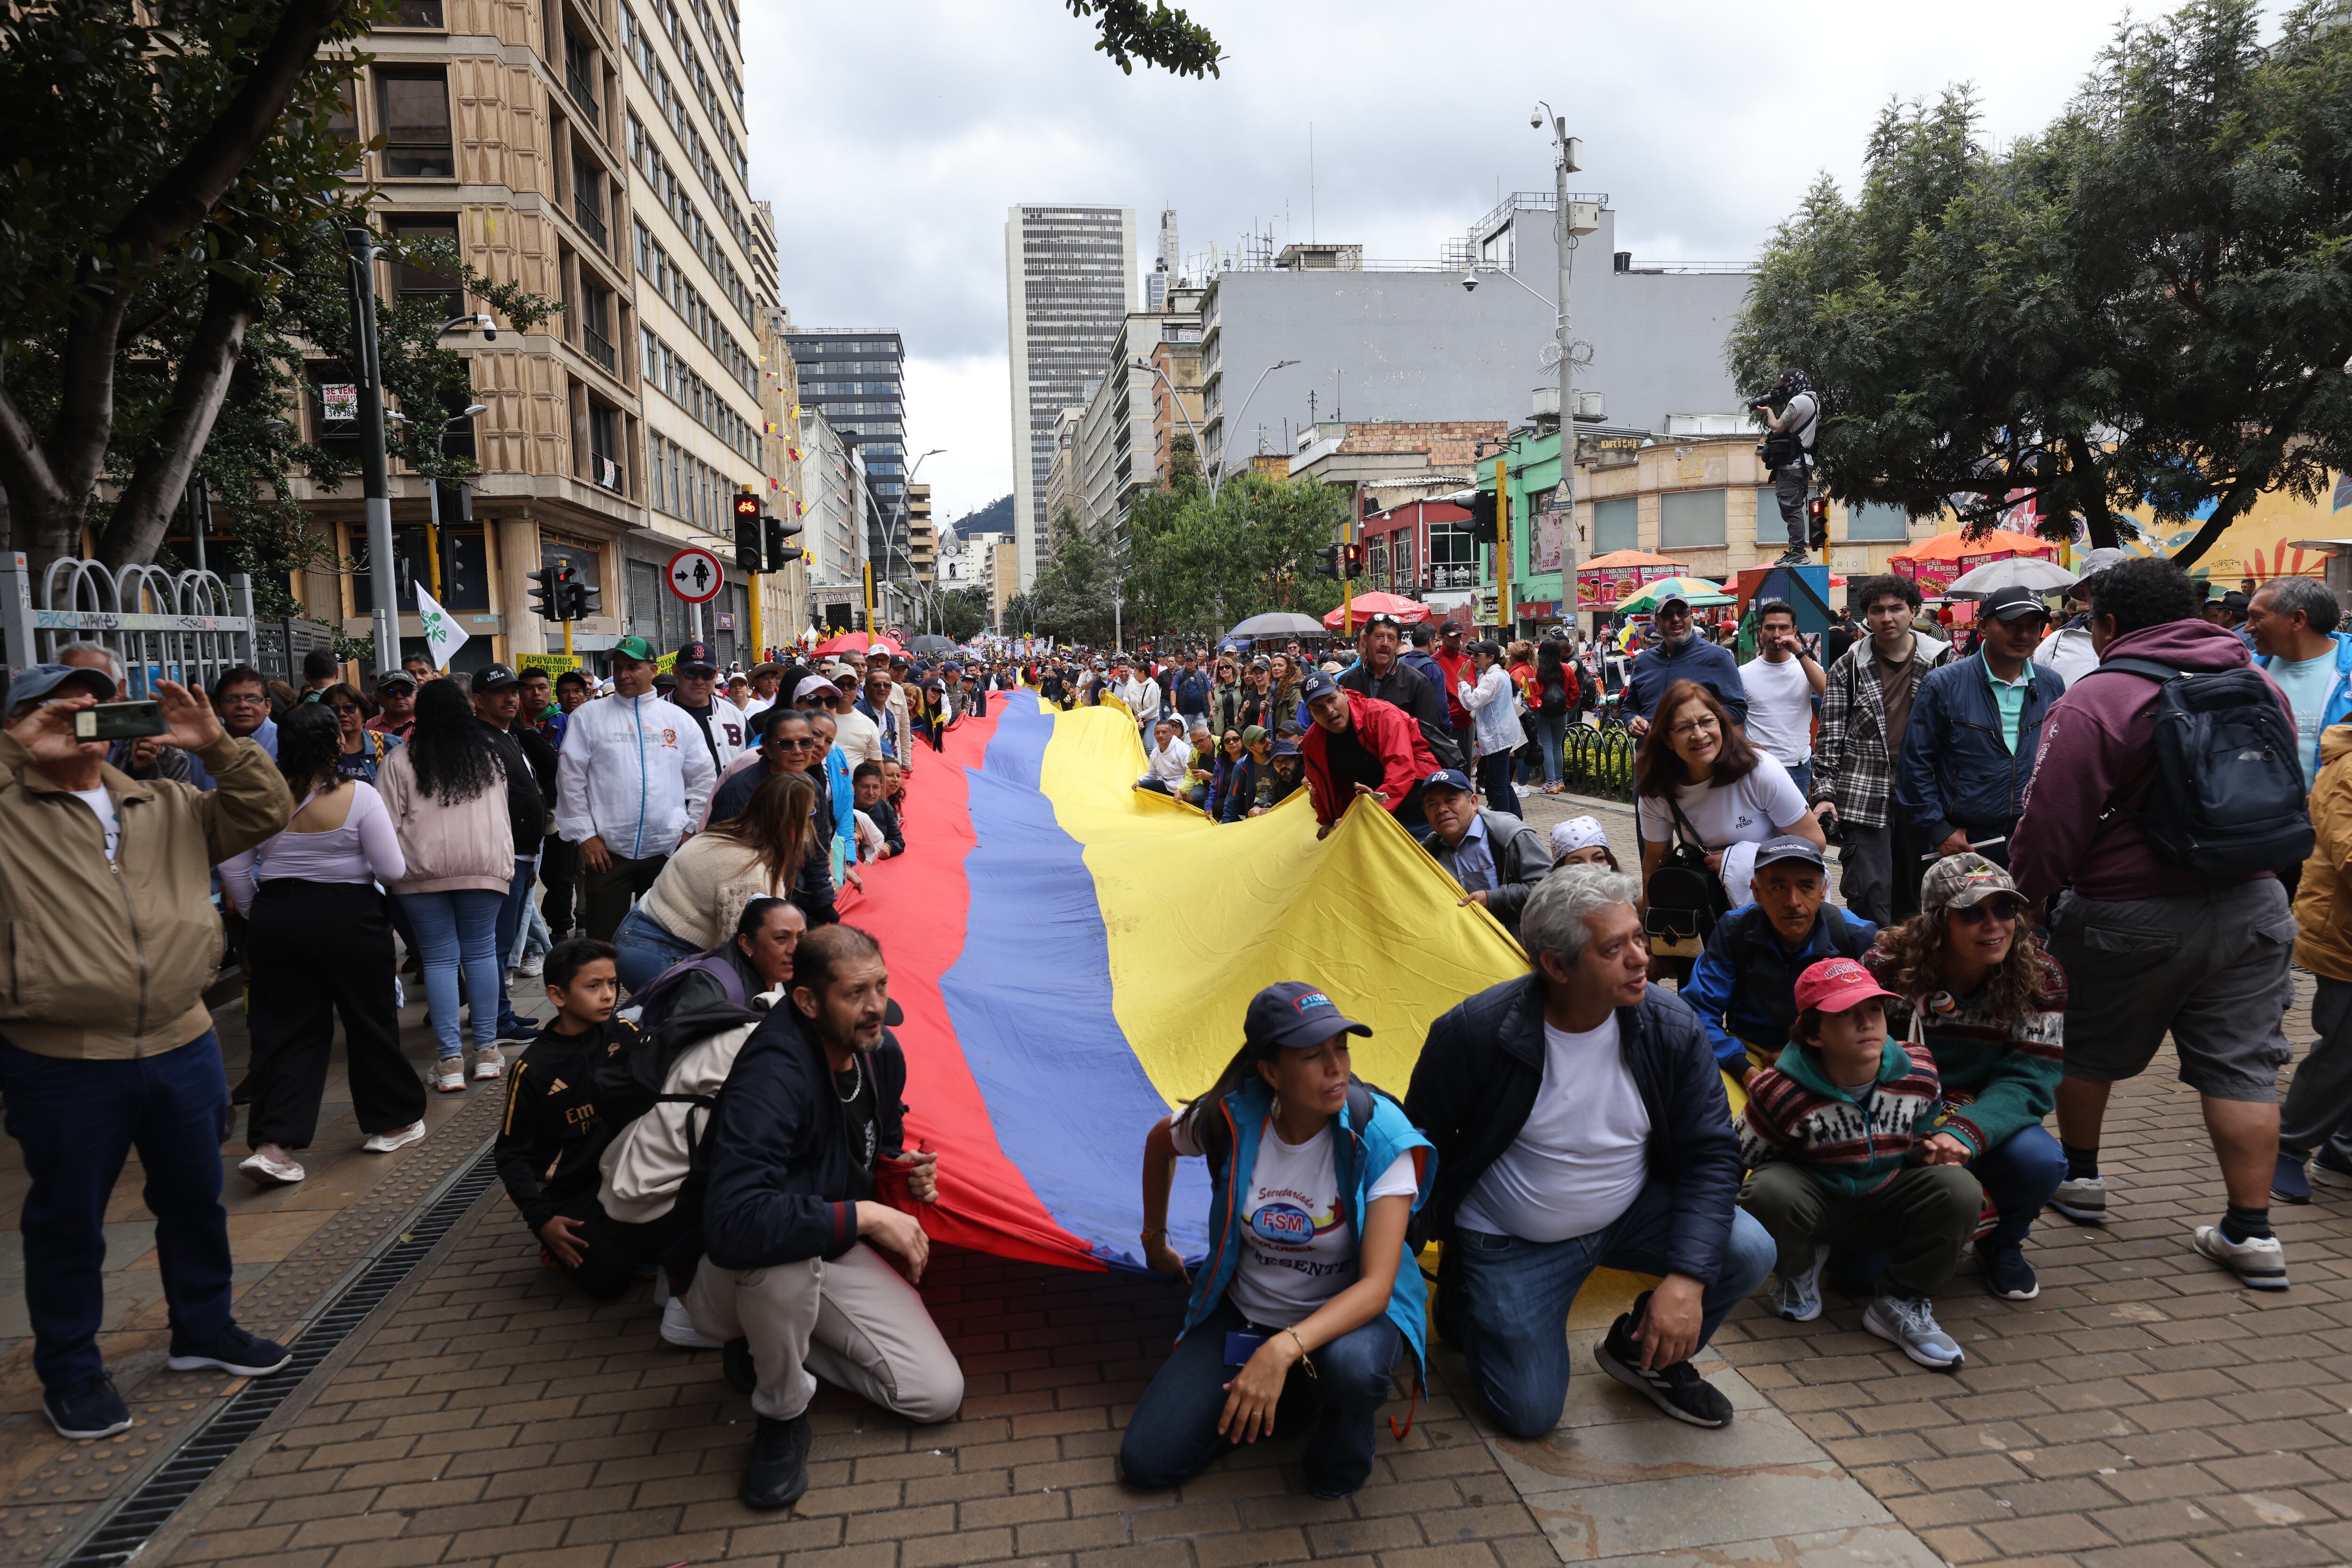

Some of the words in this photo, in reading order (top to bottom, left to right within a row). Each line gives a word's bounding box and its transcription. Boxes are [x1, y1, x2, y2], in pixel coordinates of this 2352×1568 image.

[327, 395, 350, 403] ARRIENDA
[1542, 558, 1558, 568] $50.000
[1963, 556, 1991, 565] SUPER
[692, 645, 705, 659] B
[525, 656, 572, 665] APOYAMOS
[534, 664, 576, 673] CONSULTA
[723, 724, 742, 747] B
[2039, 742, 2050, 765] Center
[1736, 819, 1753, 829] FENDI
[1258, 1187, 1314, 1209] Secretariado
[1262, 1210, 1303, 1233] FSM
[1250, 1235, 1317, 1253] COLOMBIA
